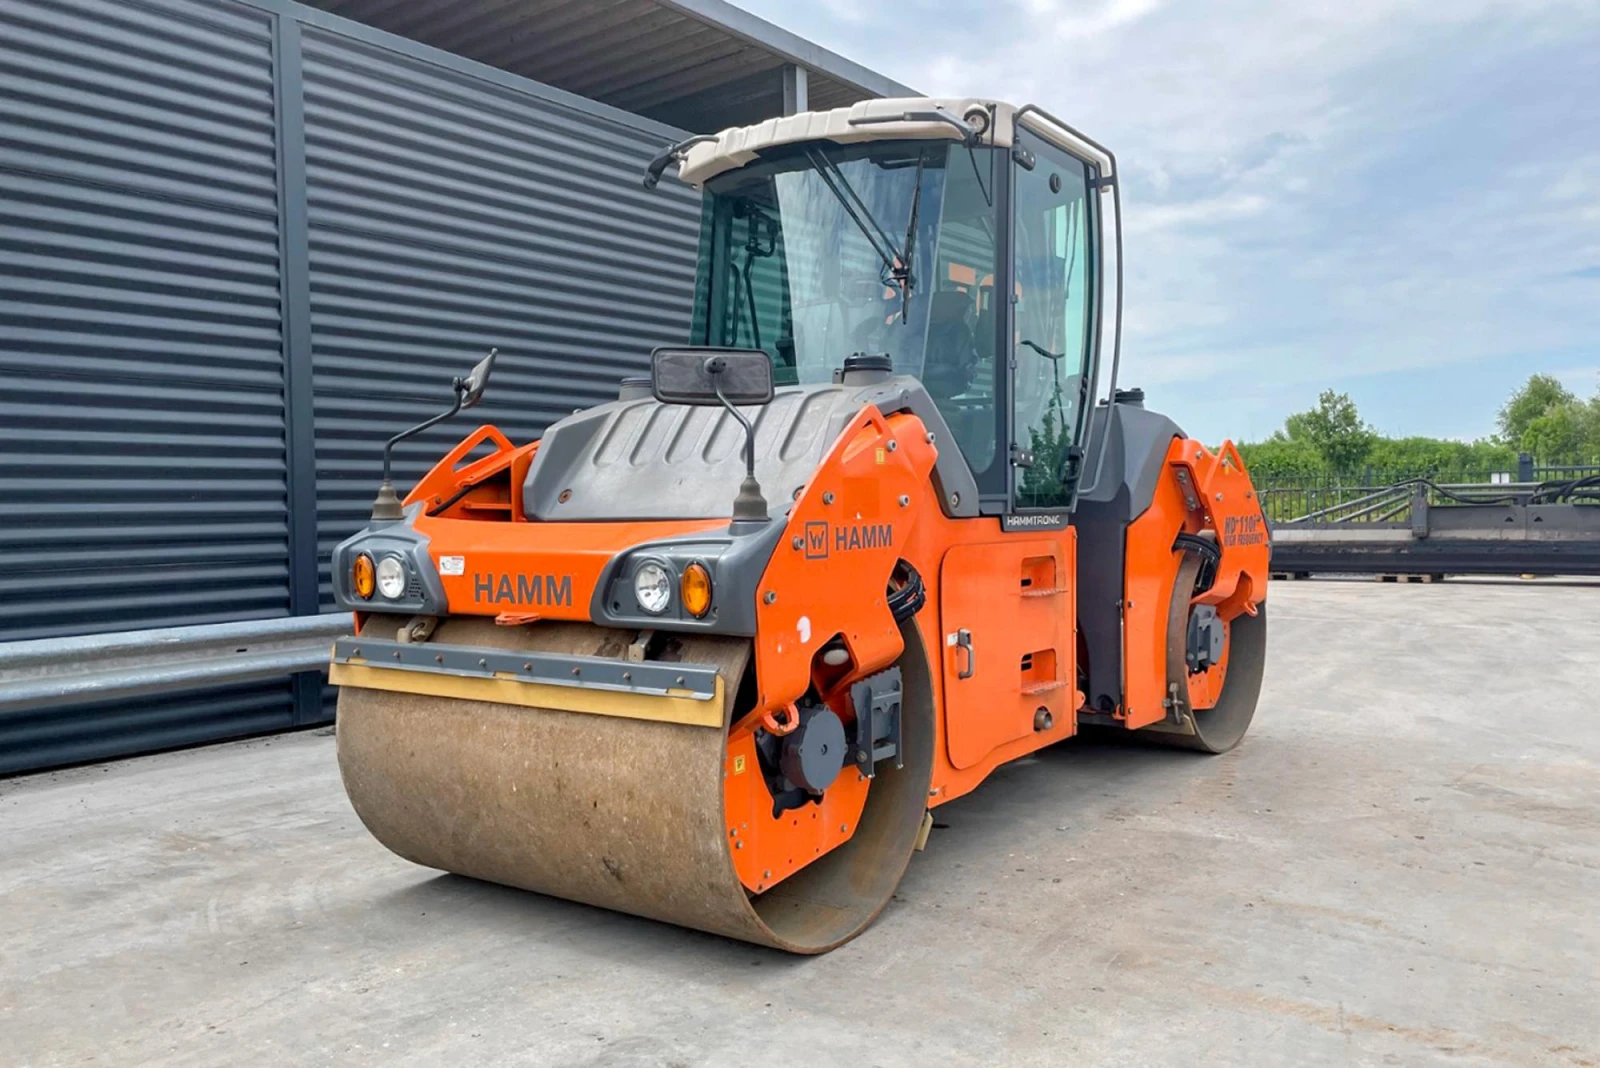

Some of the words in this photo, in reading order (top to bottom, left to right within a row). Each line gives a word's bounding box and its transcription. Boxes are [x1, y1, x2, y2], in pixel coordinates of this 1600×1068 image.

[1007, 515, 1060, 526] HAMMTRONIC
[835, 524, 893, 551] HAMM
[474, 573, 572, 607] HAMM
